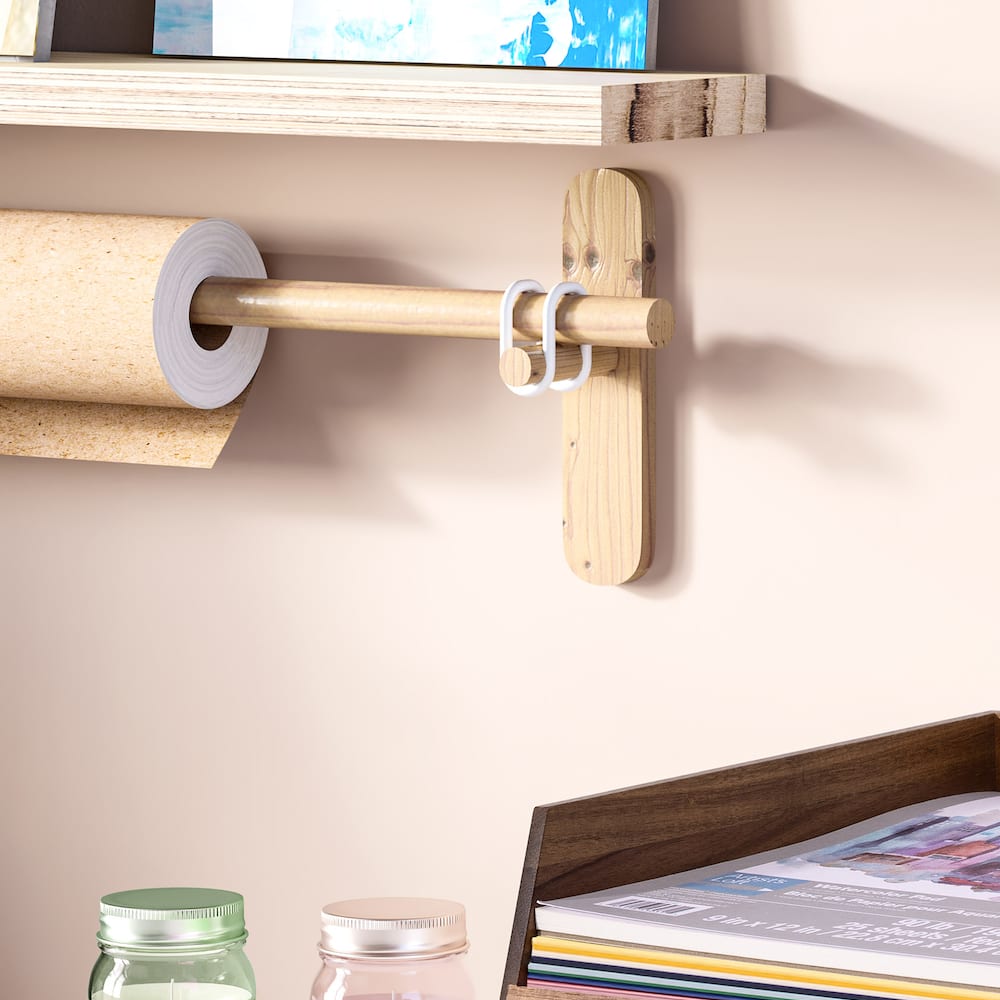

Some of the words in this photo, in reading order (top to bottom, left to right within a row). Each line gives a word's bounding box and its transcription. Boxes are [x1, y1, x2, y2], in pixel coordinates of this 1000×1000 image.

[783, 890, 821, 899] Bloc
[847, 898, 900, 909] Papier
[898, 904, 949, 913] pour
[813, 883, 908, 897] Watercolor
[909, 894, 948, 902] Pad
[832, 921, 873, 930] 25
[869, 926, 949, 939] sheets
[891, 918, 931, 928] 90
[925, 921, 954, 930] lb
[702, 914, 728, 922] 9
[720, 917, 749, 926] in
[743, 920, 768, 928] x
[765, 922, 801, 931] 12
[791, 926, 822, 936] in
[832, 931, 891, 942] 22.8
[883, 938, 924, 947] cm
[940, 944, 1000, 954] 30.4
